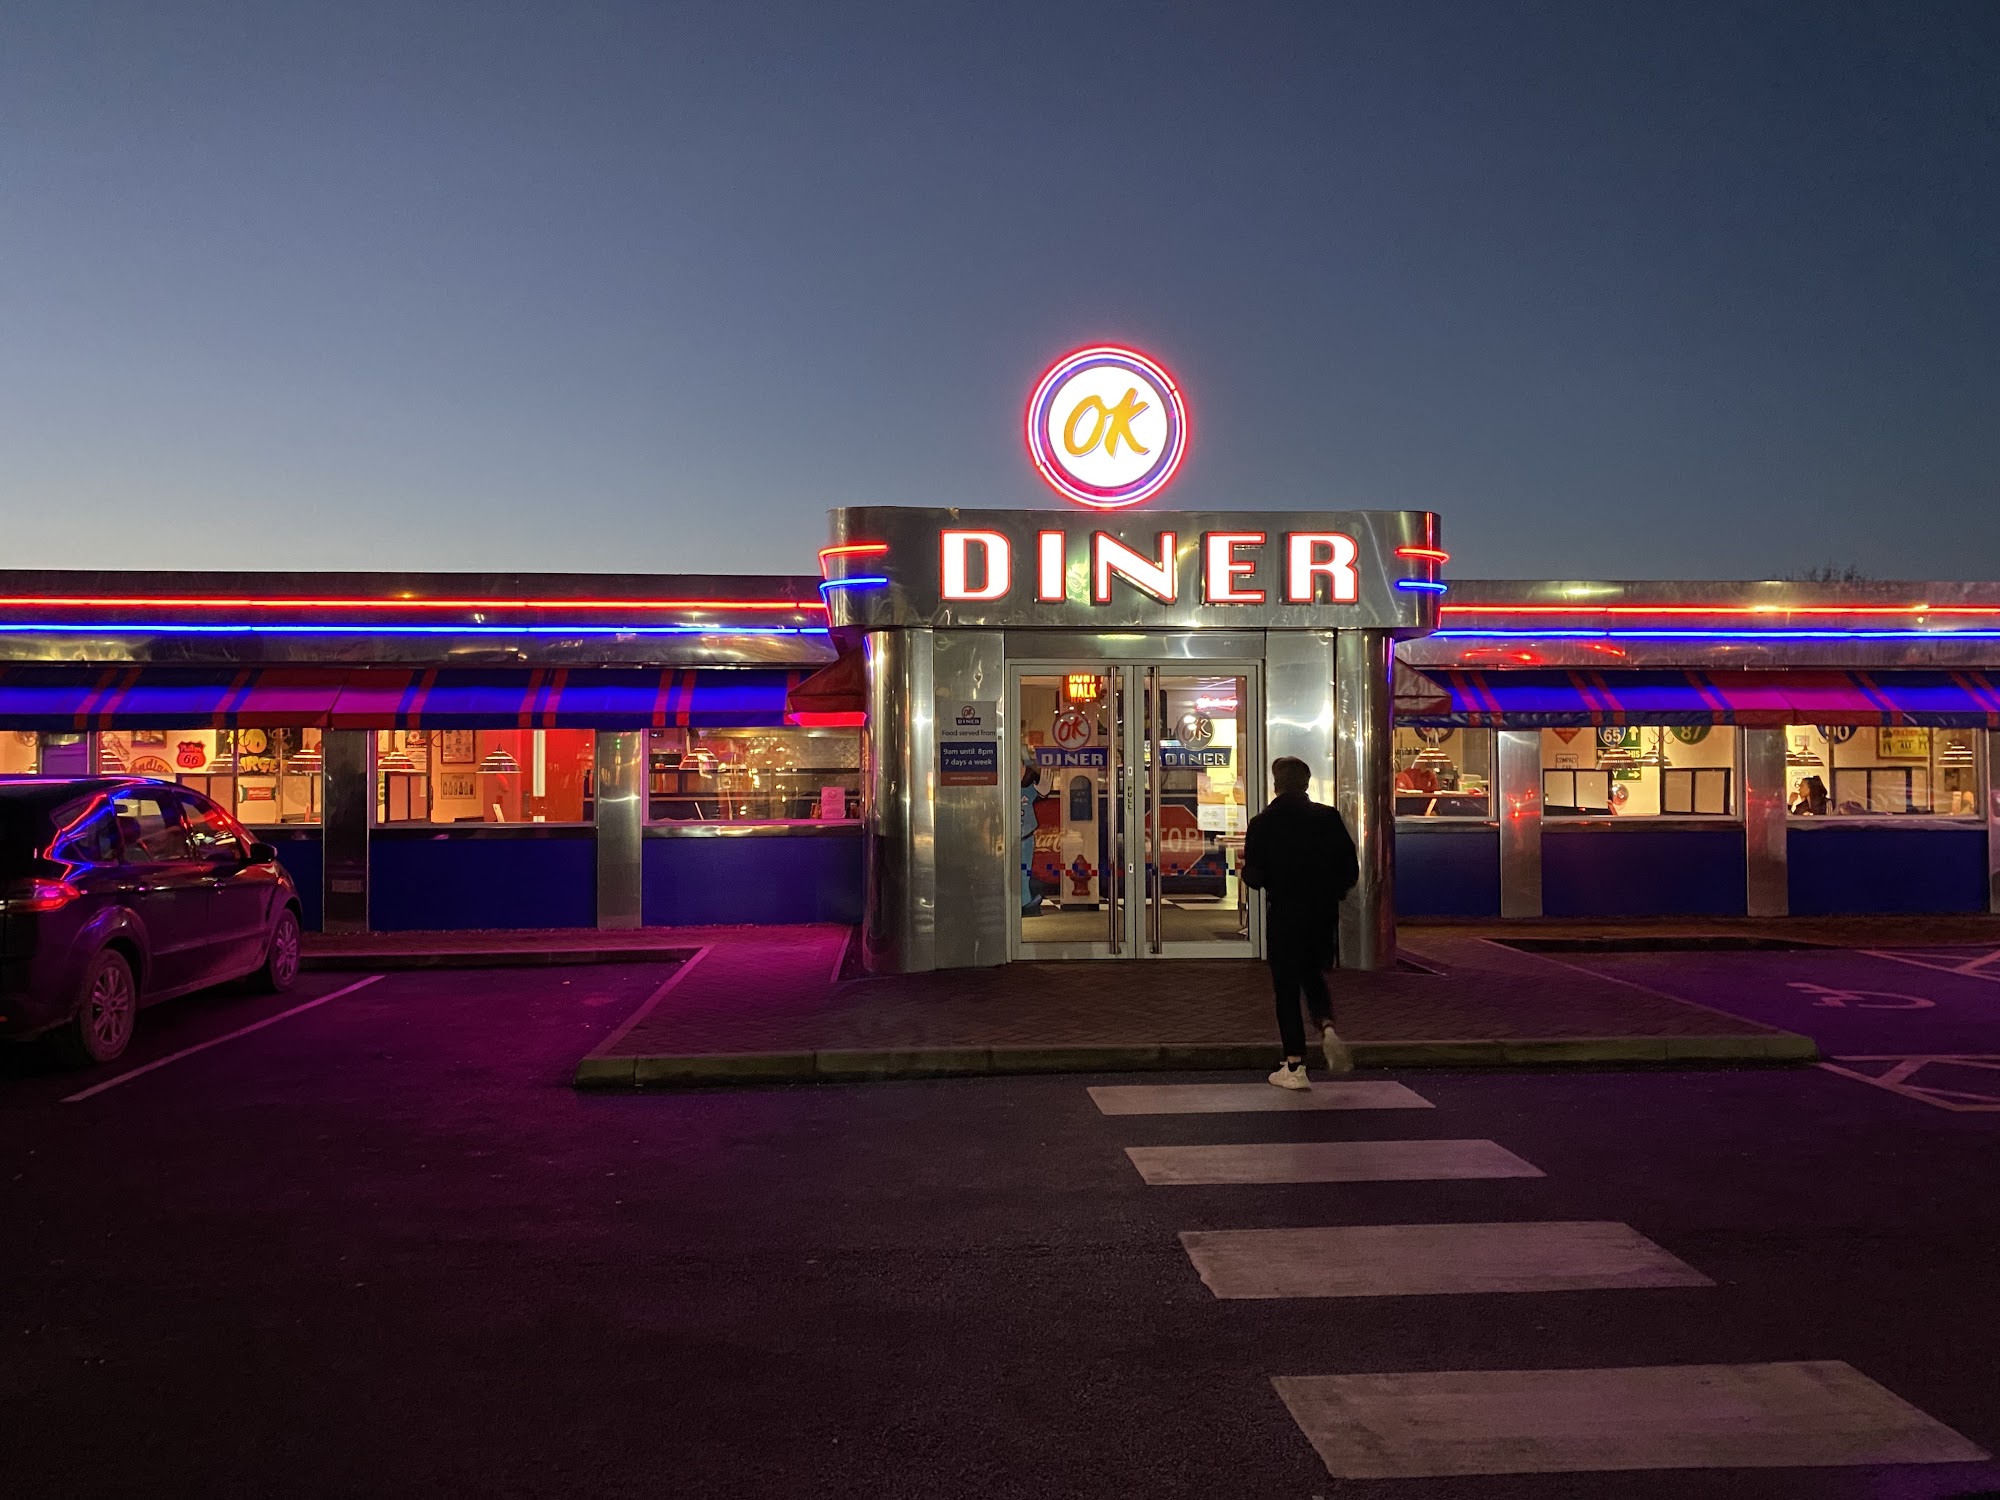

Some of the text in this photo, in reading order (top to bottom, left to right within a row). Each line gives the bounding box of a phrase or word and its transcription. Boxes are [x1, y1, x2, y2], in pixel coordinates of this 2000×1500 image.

[1064, 388, 1150, 459] OK
[939, 529, 1360, 603] DINER
[1069, 683, 1097, 698] WALK
[1058, 716, 1087, 742] OK
[1182, 716, 1211, 742] OK
[1603, 727, 1621, 743] 65
[183, 754, 199, 765] 66
[977, 748, 994, 756] 8pm
[1041, 753, 1104, 766] DINER
[1165, 753, 1227, 766] DINER
[950, 758, 967, 767] days
